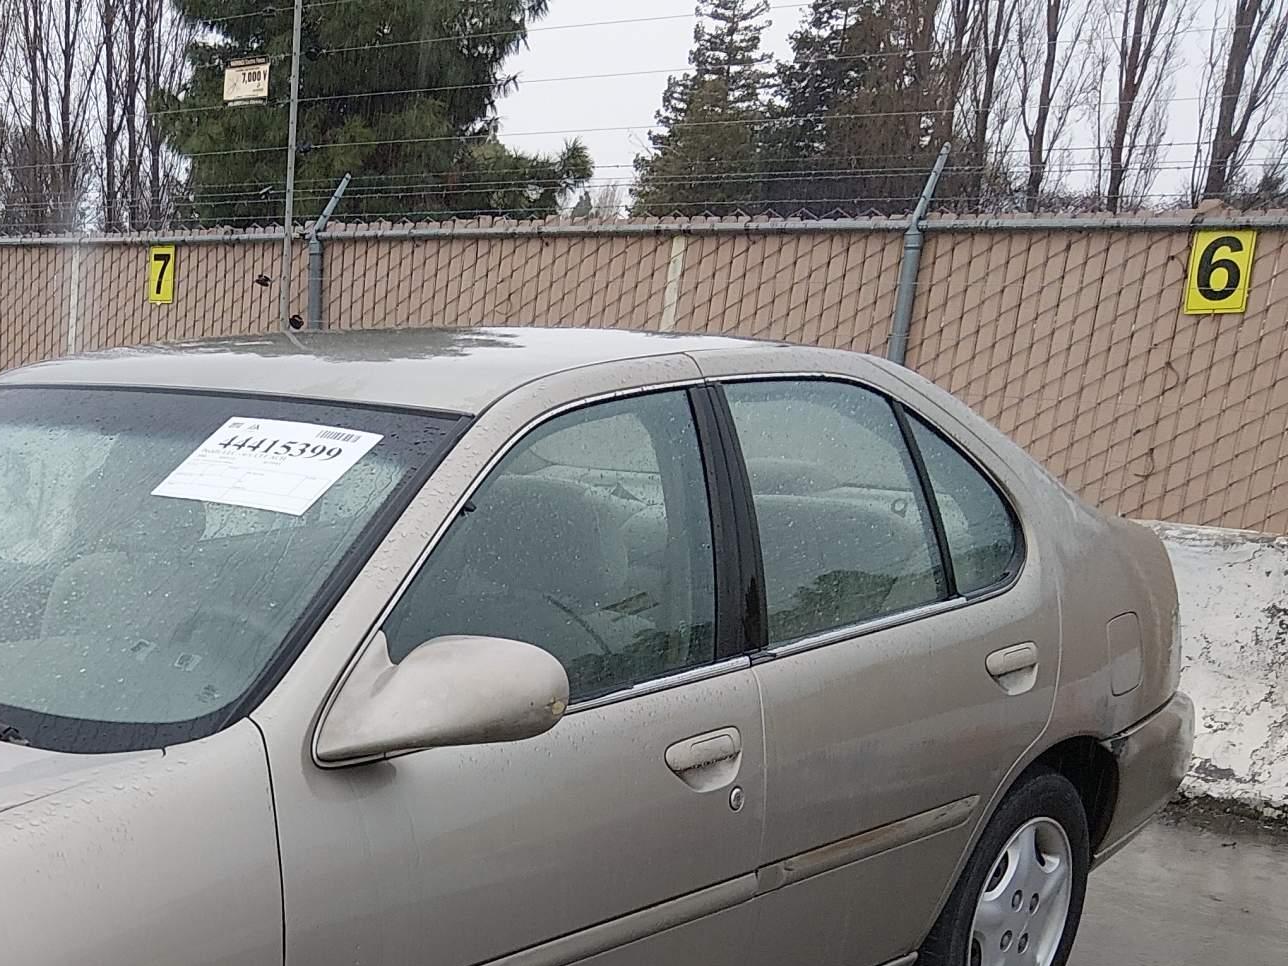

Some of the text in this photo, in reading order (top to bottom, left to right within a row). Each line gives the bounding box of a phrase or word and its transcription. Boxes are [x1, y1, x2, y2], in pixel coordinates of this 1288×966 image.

[241, 70, 262, 85] 7,000
[153, 253, 171, 295] 7
[1196, 235, 1244, 302] 6
[217, 434, 343, 462] 44415399
